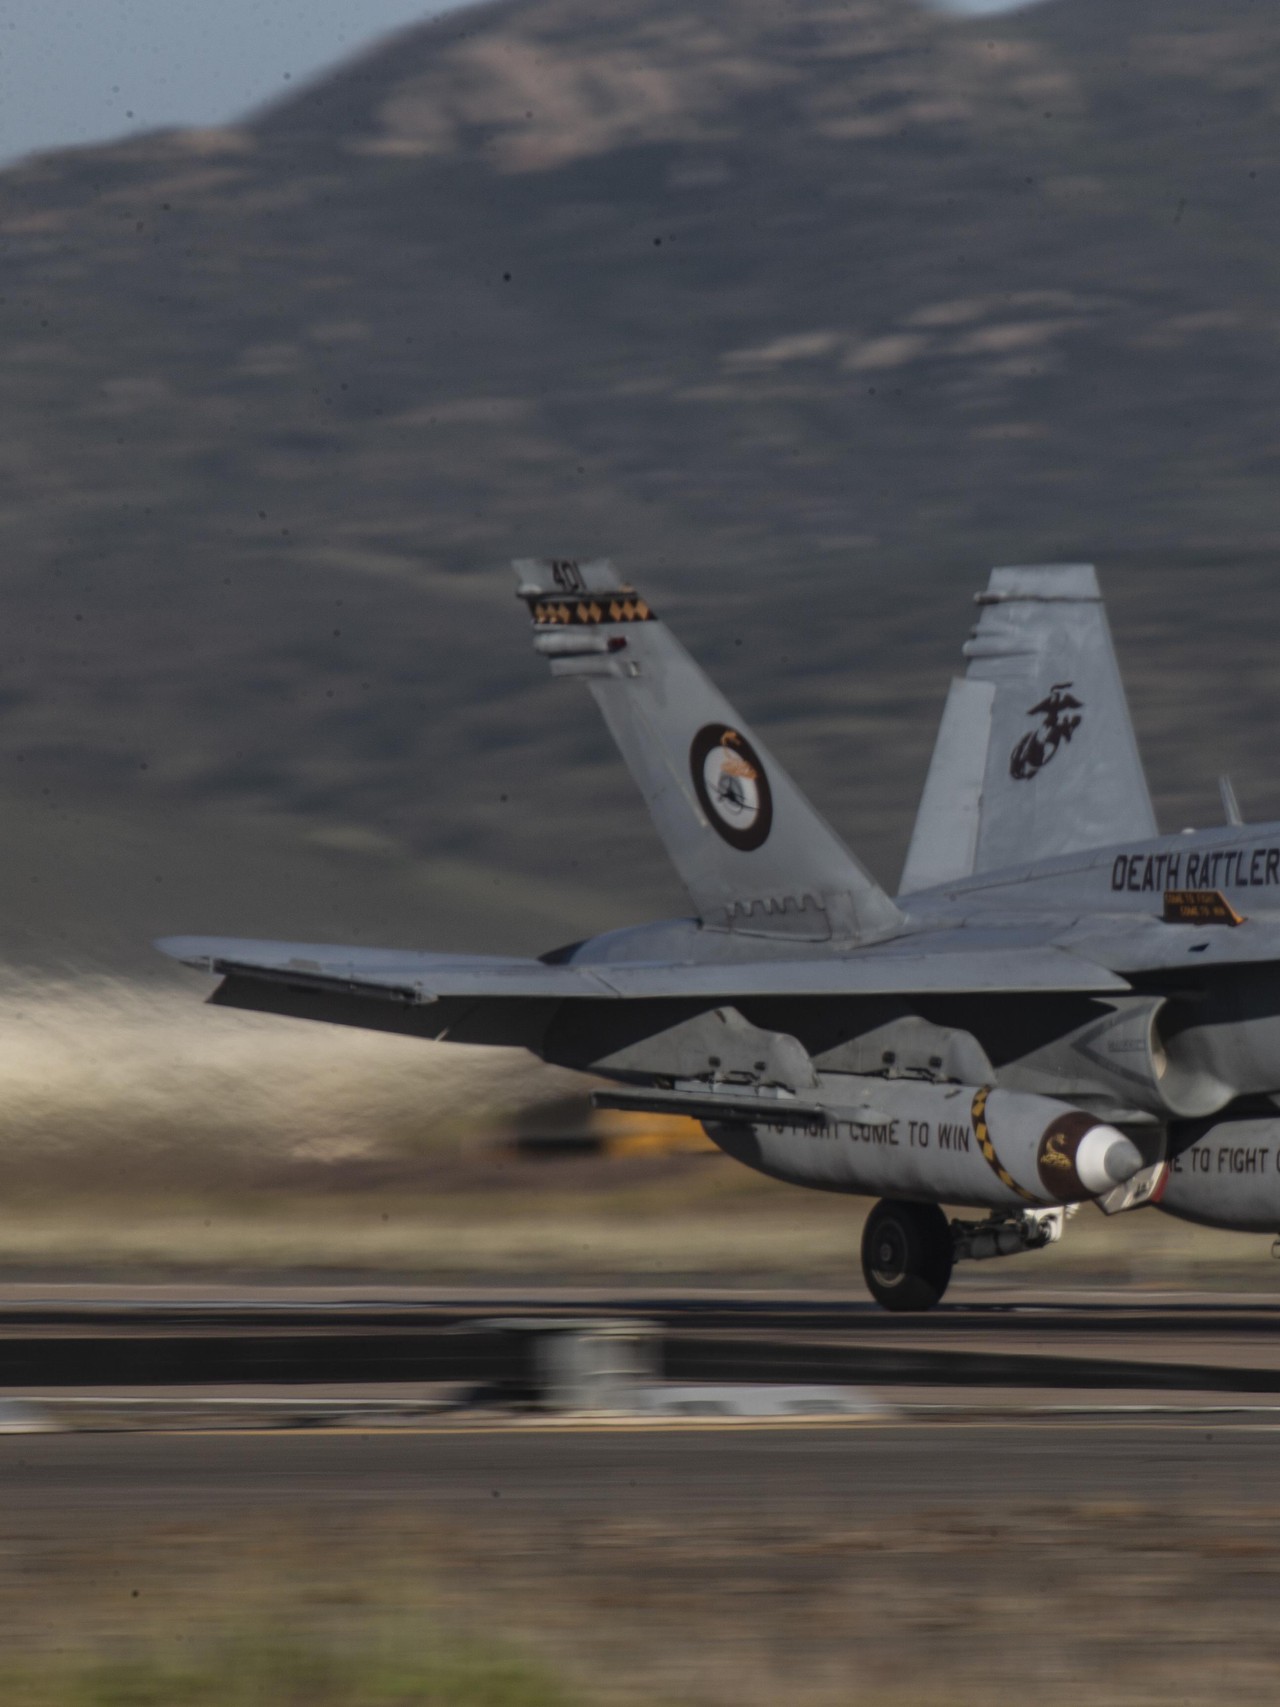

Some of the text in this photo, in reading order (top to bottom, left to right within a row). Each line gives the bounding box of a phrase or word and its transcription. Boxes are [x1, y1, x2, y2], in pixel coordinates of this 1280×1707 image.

[552, 560, 588, 593] 401
[1111, 853, 1180, 891] DEATH
[849, 1118, 899, 1146] COME
[908, 1120, 929, 1148] TO
[937, 1122, 970, 1152] WIN
[1191, 1147, 1210, 1172] TO
[1218, 1147, 1269, 1173] FIGHT
